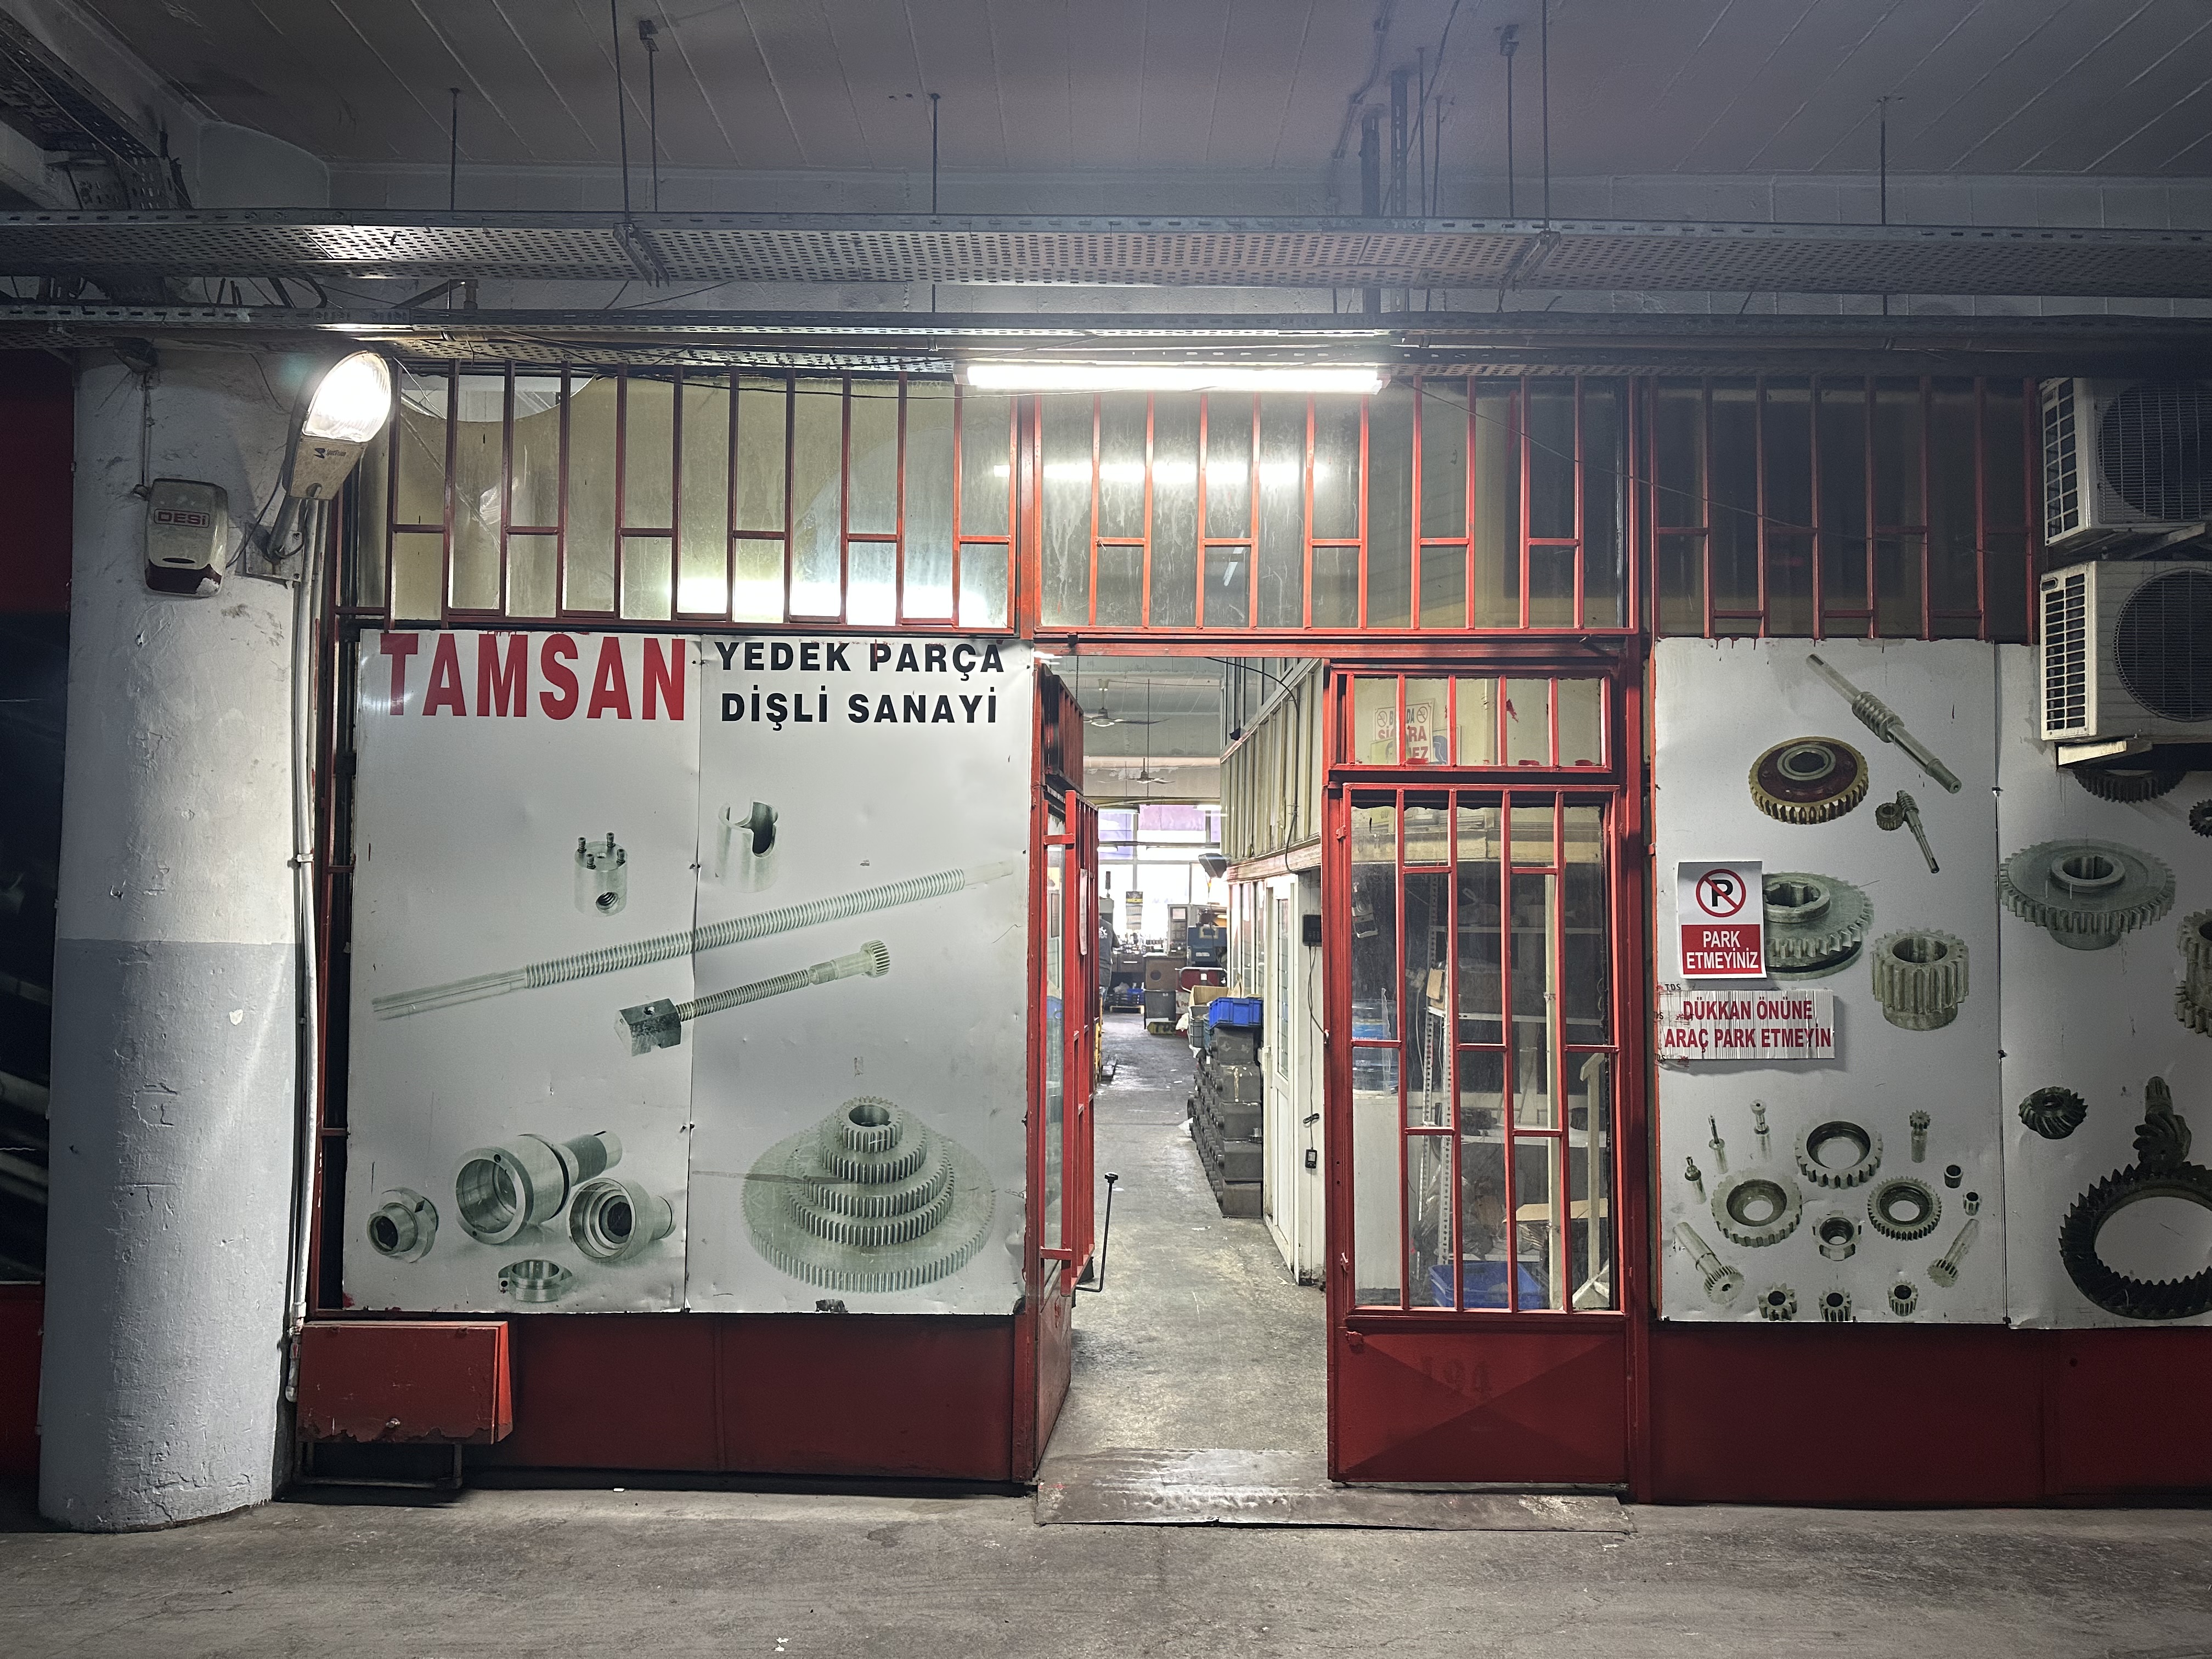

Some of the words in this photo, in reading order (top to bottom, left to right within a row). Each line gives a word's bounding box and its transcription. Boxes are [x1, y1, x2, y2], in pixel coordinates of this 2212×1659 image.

[714, 642, 851, 671] YEDEK
[870, 643, 1004, 681] PARÇA
[380, 633, 685, 720] TAMSAN
[722, 685, 827, 731] DİŞLİ
[848, 687, 996, 723] SANAYİ
[1711, 879, 1734, 907] P
[1703, 930, 1740, 948] PARK
[1686, 947, 1759, 969] ETMEYİNİZ
[1683, 997, 1751, 1020] DÜKKAN
[1757, 997, 1813, 1019] ÖNÜNE
[1664, 1028, 1709, 1053] ARAÇ
[1714, 1028, 1756, 1047] PARK
[1761, 1024, 1831, 1047] ETMEYİN
